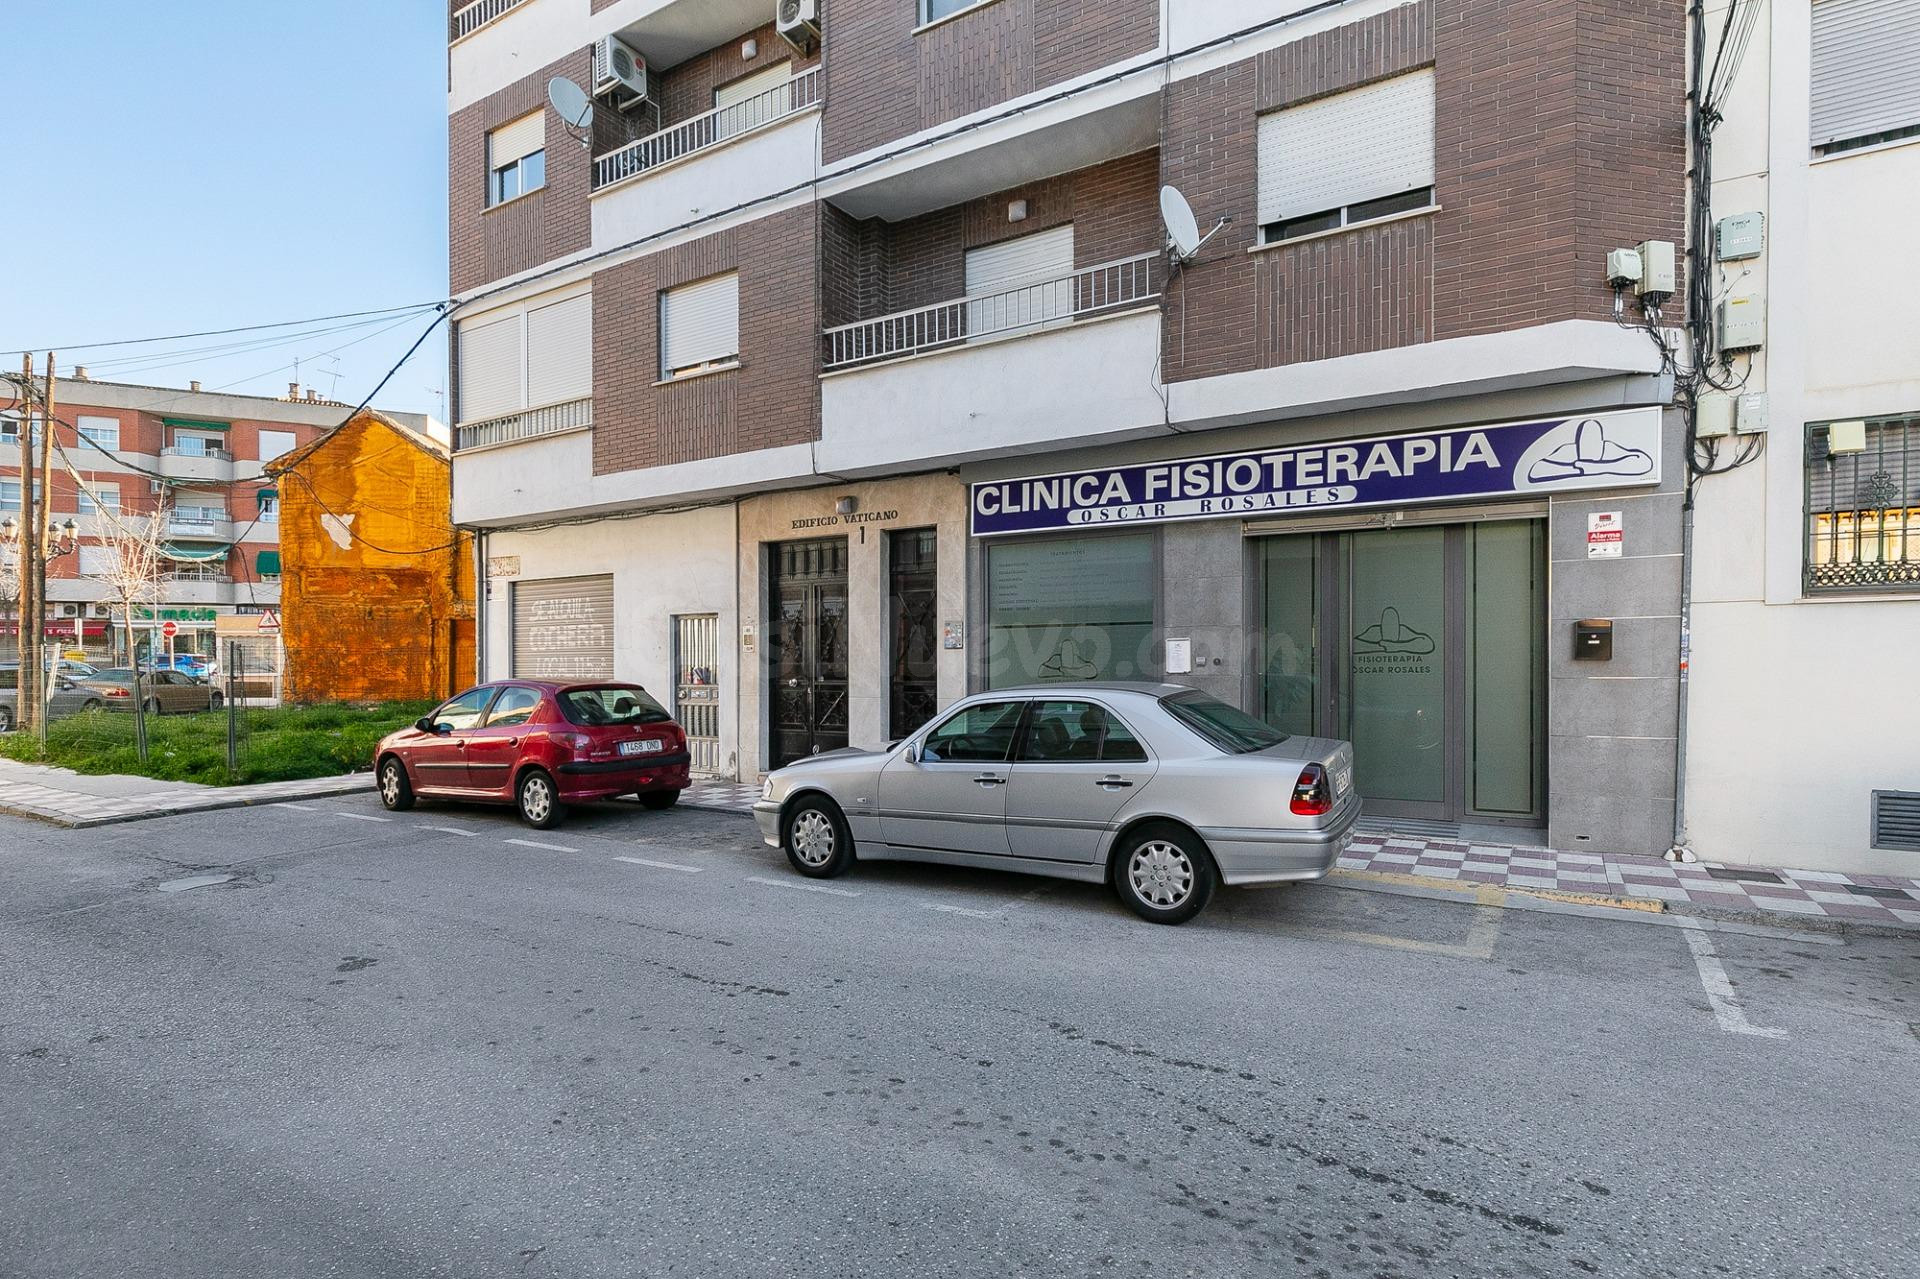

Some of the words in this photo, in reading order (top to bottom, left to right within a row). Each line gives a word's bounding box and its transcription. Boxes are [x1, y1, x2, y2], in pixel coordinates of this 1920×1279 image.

[976, 472, 1131, 517] CLINICA
[1144, 432, 1502, 501] FISIOTERAPIA
[1081, 503, 1166, 523] OSCAR
[1200, 487, 1340, 513] ROSALES
[791, 516, 839, 530] EDIFICIO
[843, 510, 899, 524] VATICANO
[859, 526, 865, 544] 1
[1358, 655, 1424, 663] FISIOTERAPIA
[1352, 666, 1385, 674] OSCAR
[1387, 665, 1432, 674] ROSALES
